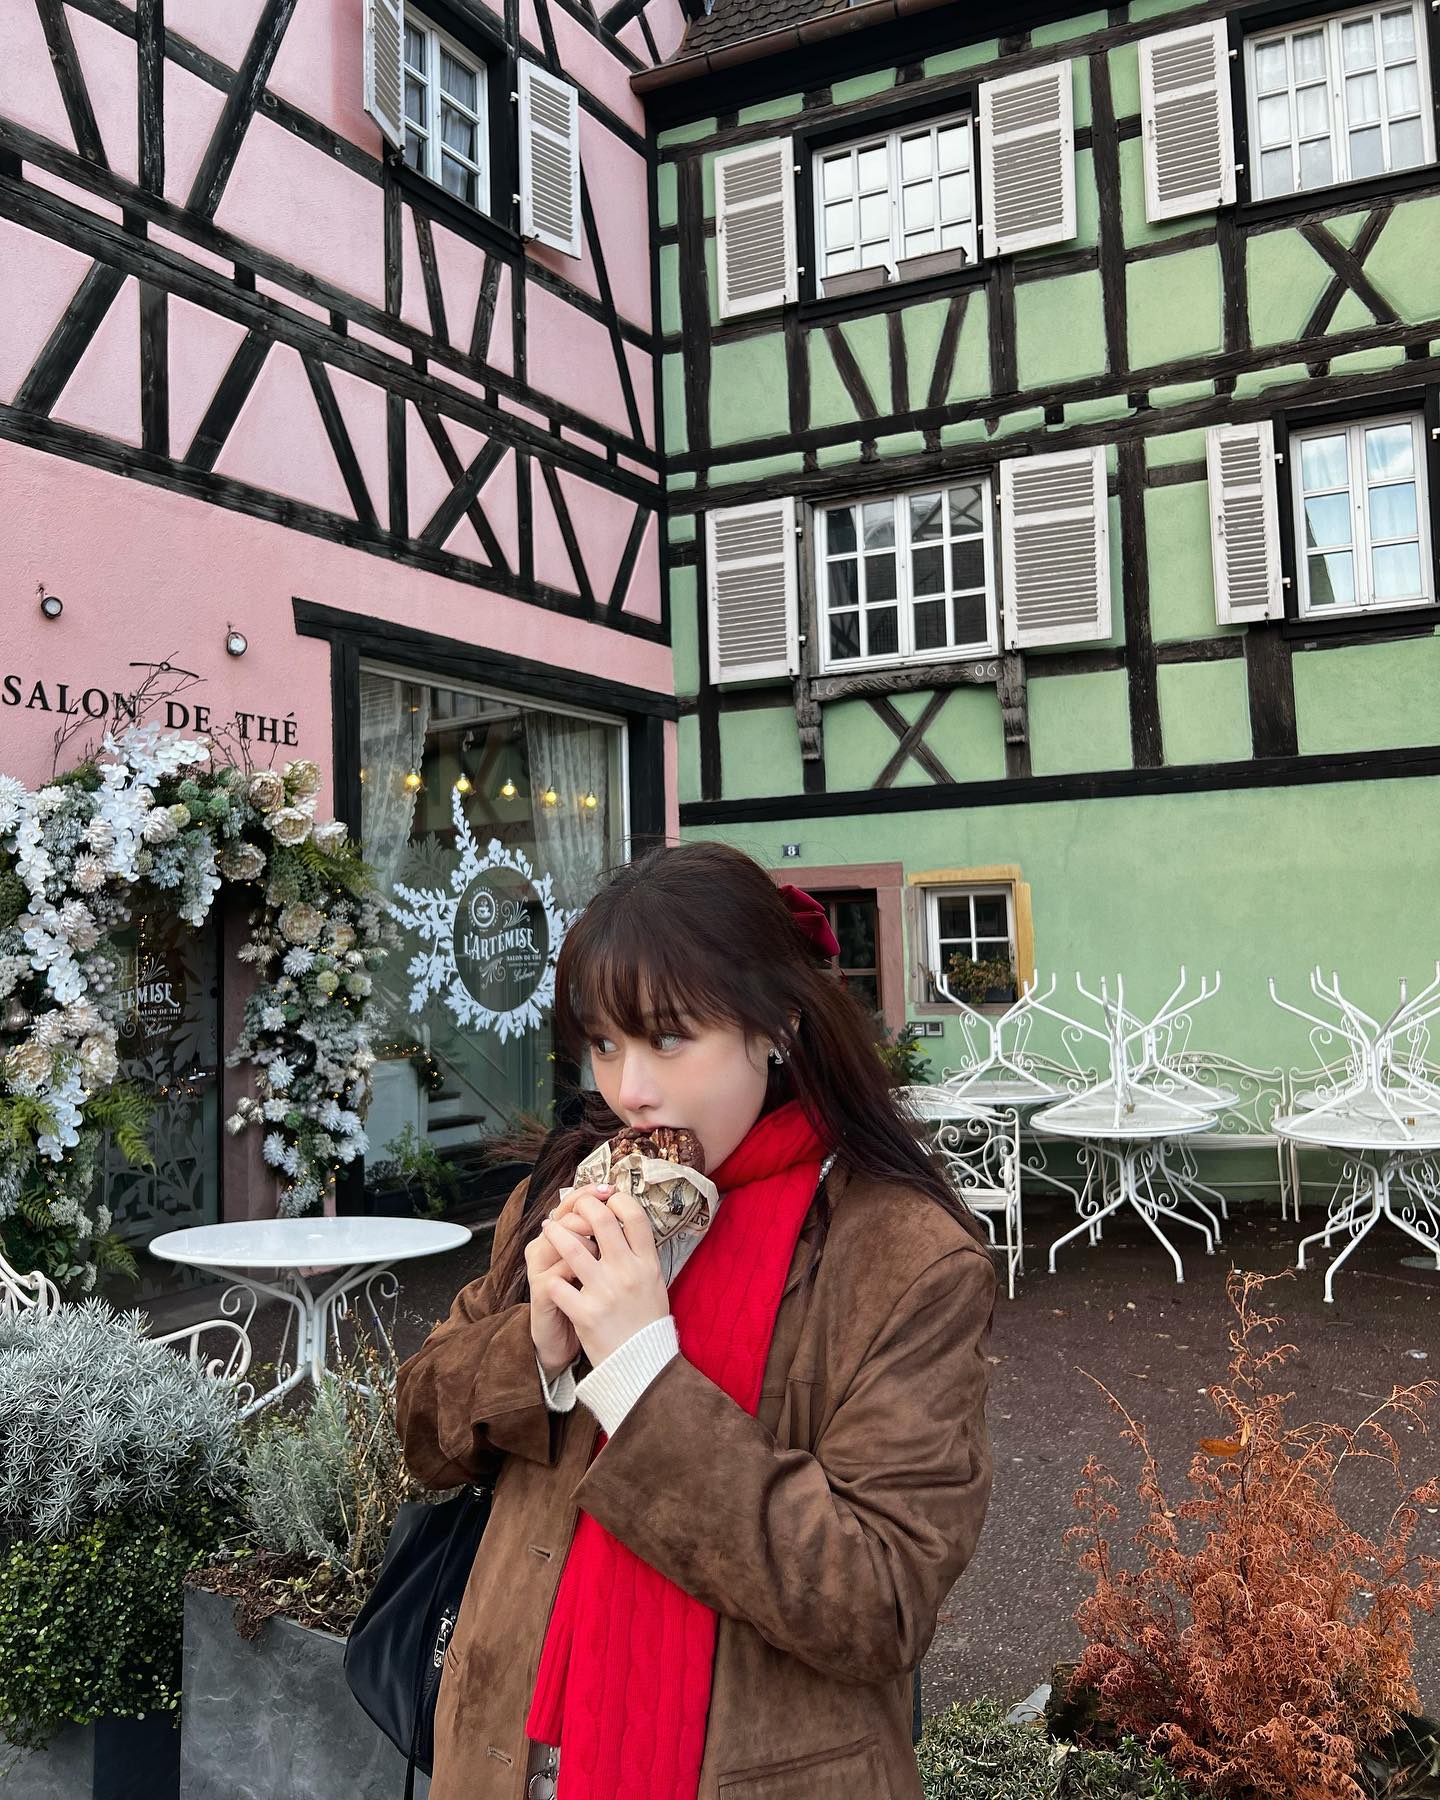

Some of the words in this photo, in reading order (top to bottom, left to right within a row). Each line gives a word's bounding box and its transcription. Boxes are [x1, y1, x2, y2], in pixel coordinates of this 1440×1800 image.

[975, 664, 997, 677] 06
[1, 675, 137, 723] SALON
[165, 701, 211, 733] DE
[235, 711, 299, 747] THÉ
[787, 845, 796, 856] 8
[464, 928, 540, 960] L'ARTÉMISE
